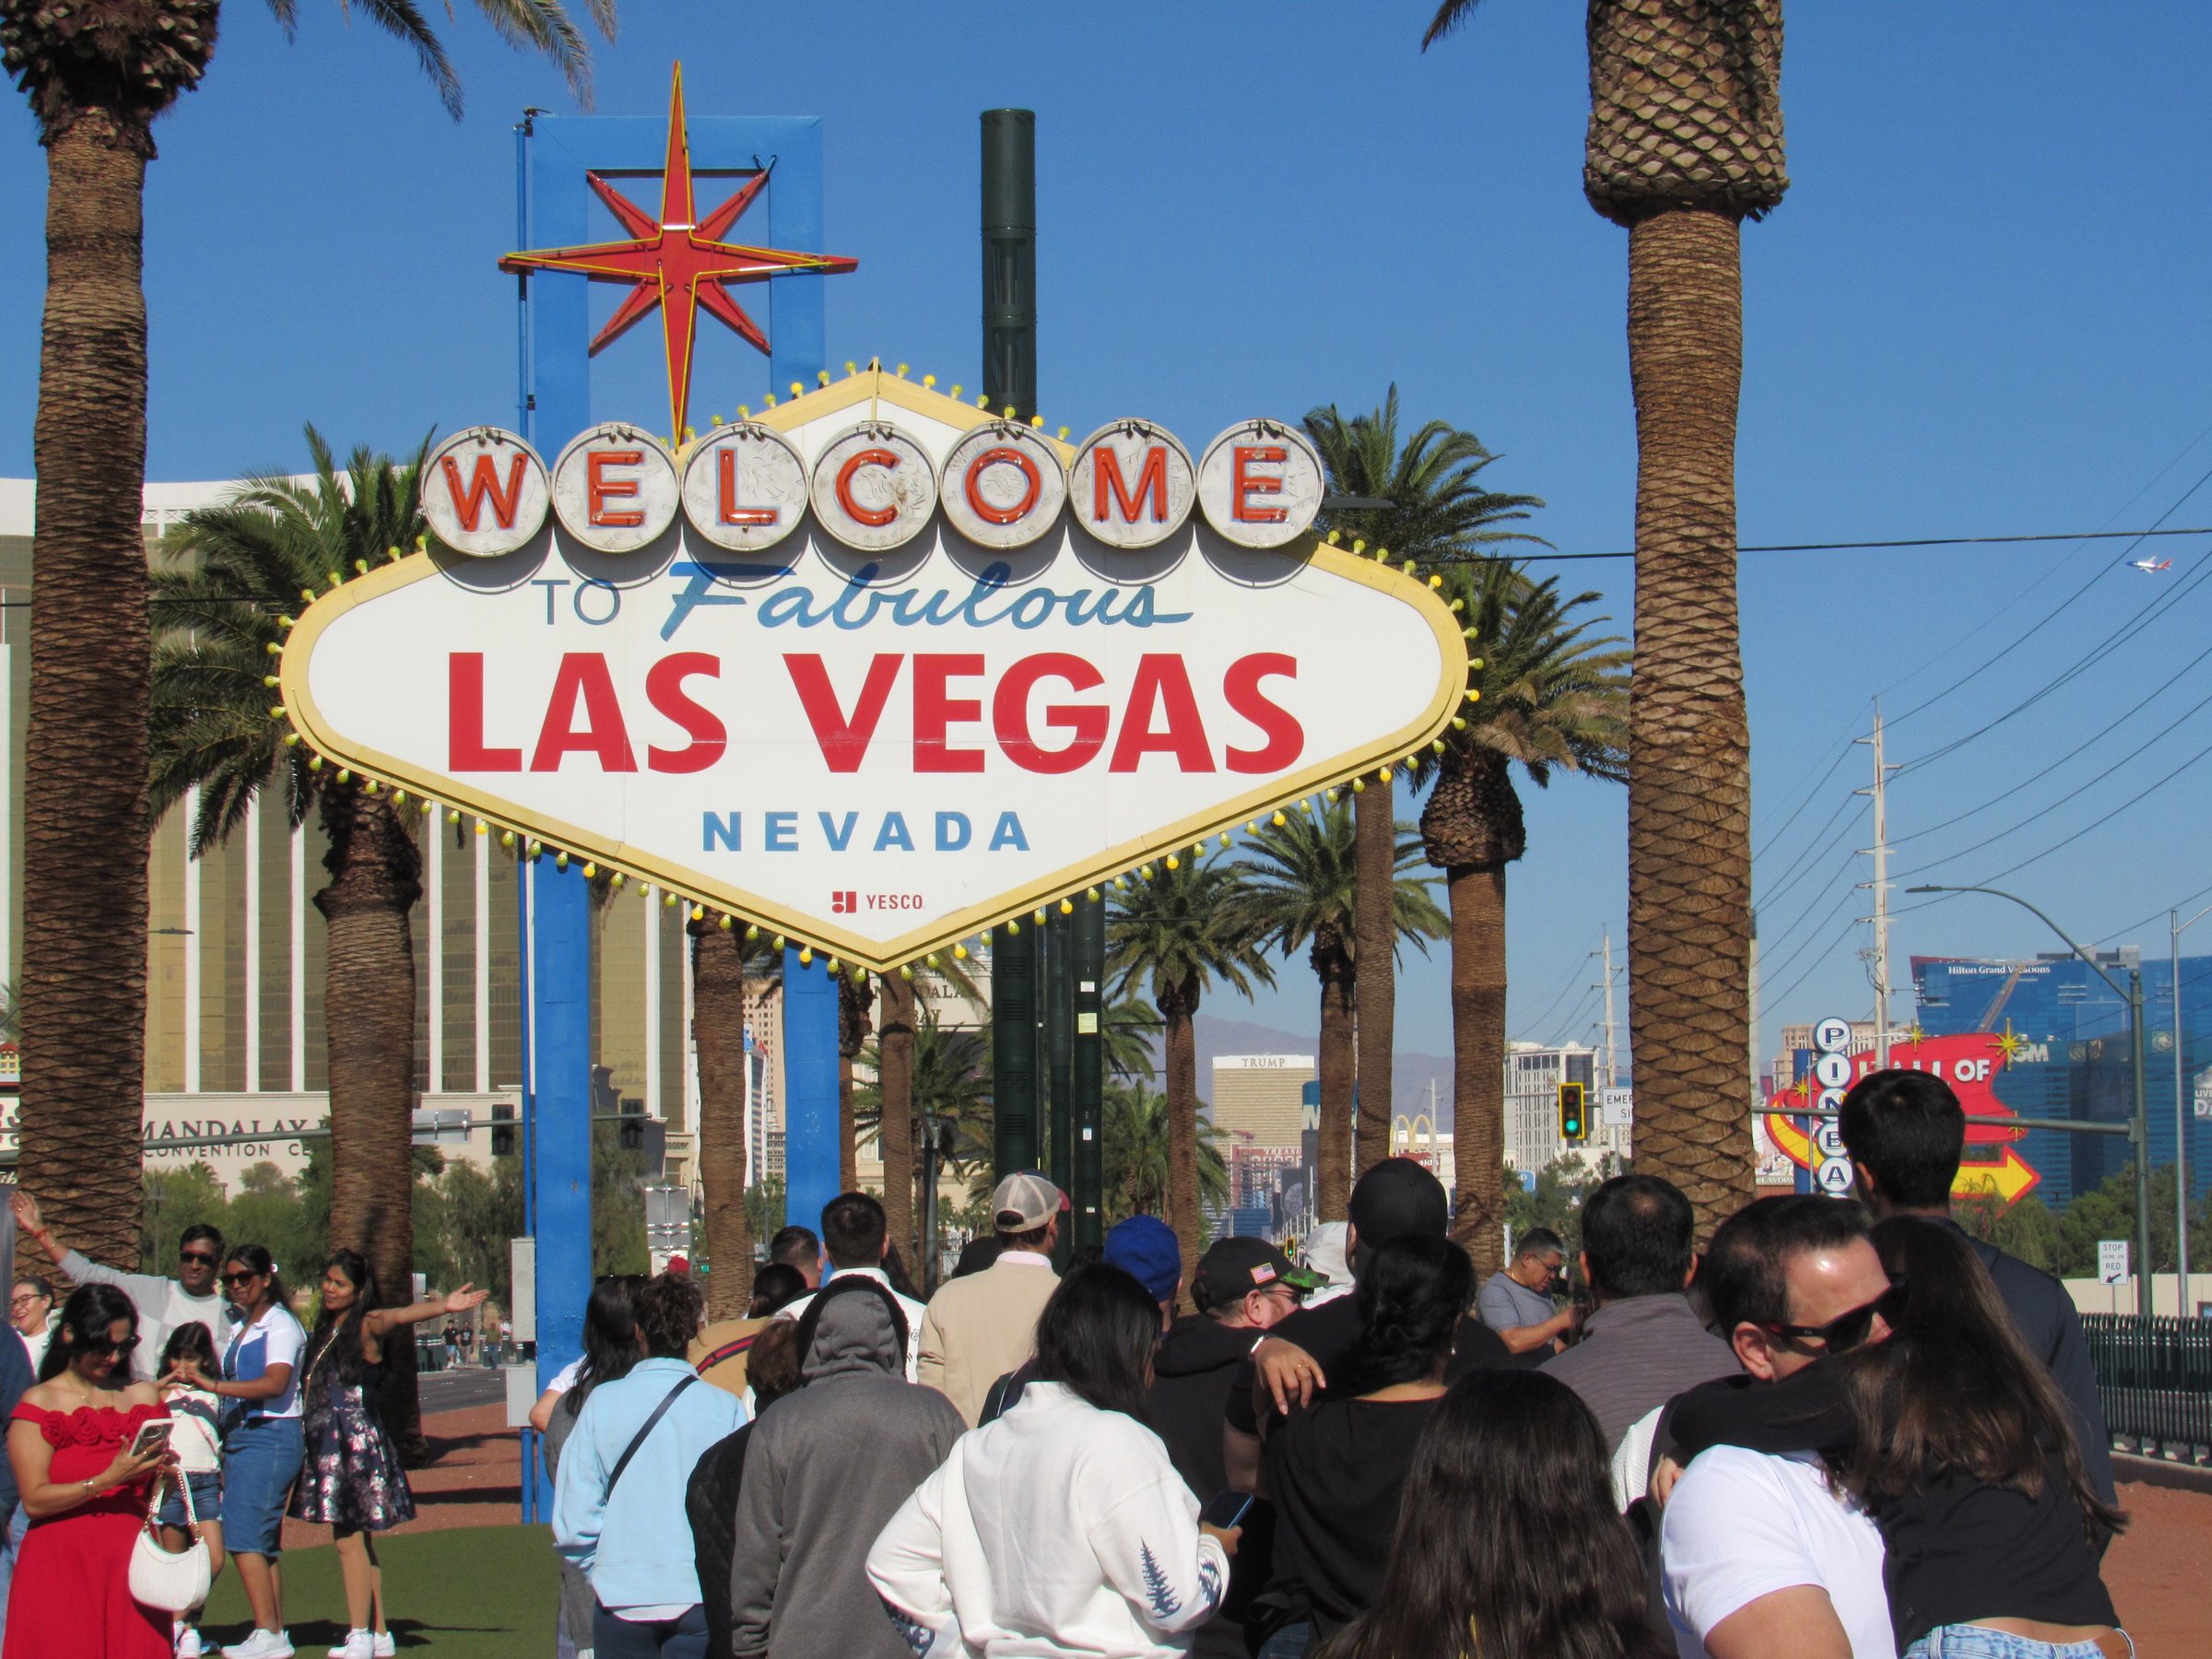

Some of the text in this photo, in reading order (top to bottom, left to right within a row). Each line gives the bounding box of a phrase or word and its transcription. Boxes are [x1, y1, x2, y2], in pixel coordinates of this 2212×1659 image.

[441, 446, 1288, 532] WELCOME
[530, 561, 1194, 642] TO Fabulous
[448, 652, 1305, 775] LAS VEGAS
[702, 811, 1030, 852] NEVADA
[866, 894, 924, 911] YESCO
[1948, 966, 2051, 974] Hilton Grand Vations
[1242, 1058, 1286, 1067] TRUMP
[1954, 1059, 1991, 1082] OF
